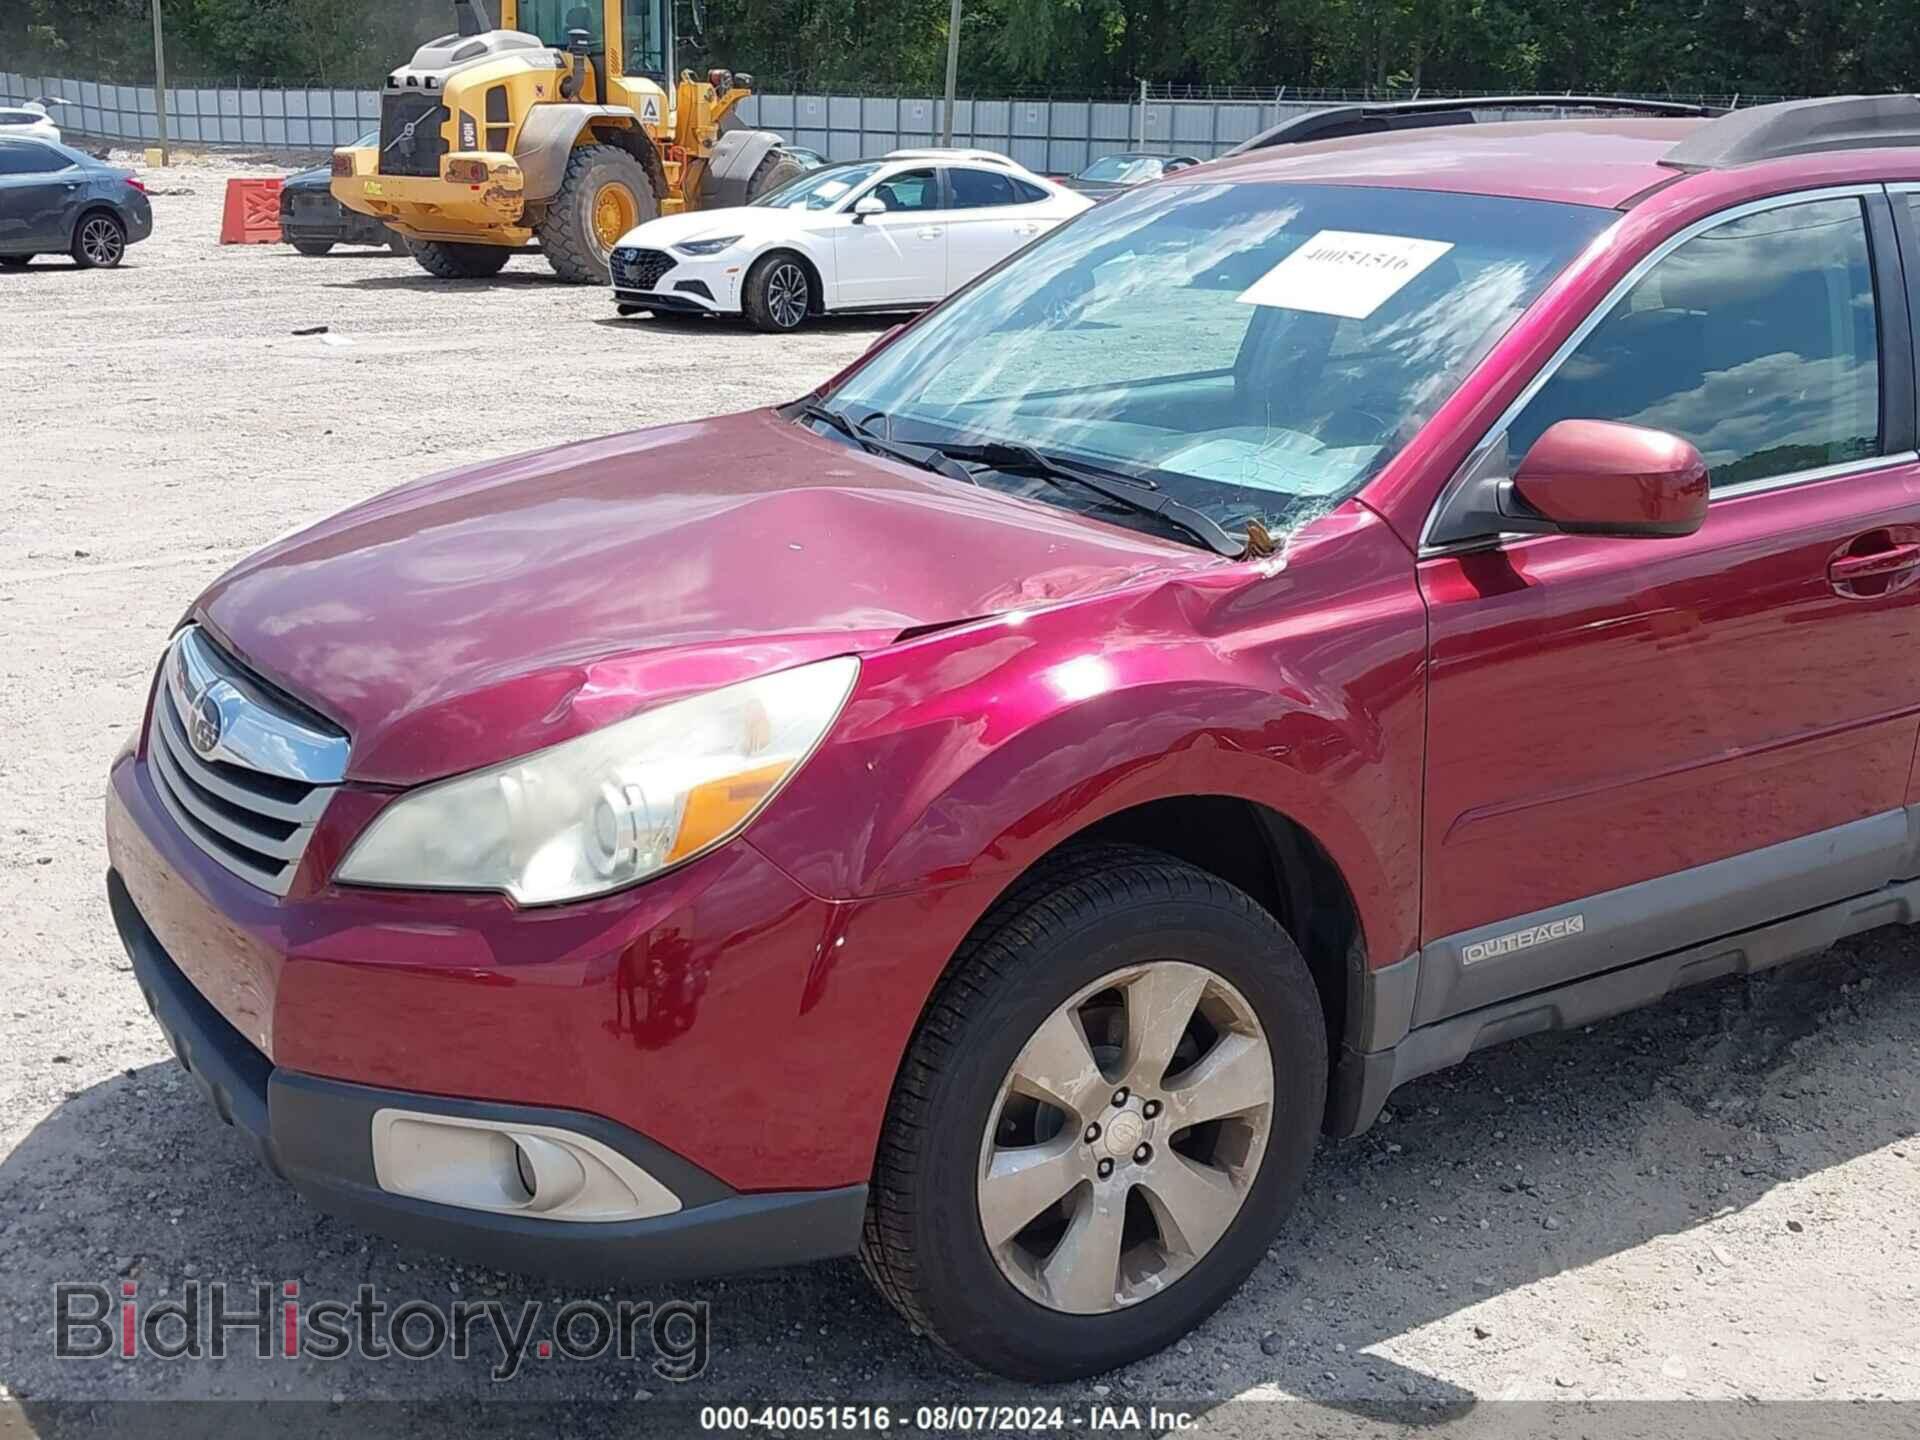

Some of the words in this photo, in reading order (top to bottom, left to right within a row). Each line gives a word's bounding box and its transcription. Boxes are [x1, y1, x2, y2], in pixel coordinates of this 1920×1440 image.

[463, 122, 475, 147] L90H
[1304, 248, 1409, 271] 40051516
[1466, 916, 1582, 962] OUTBACK
